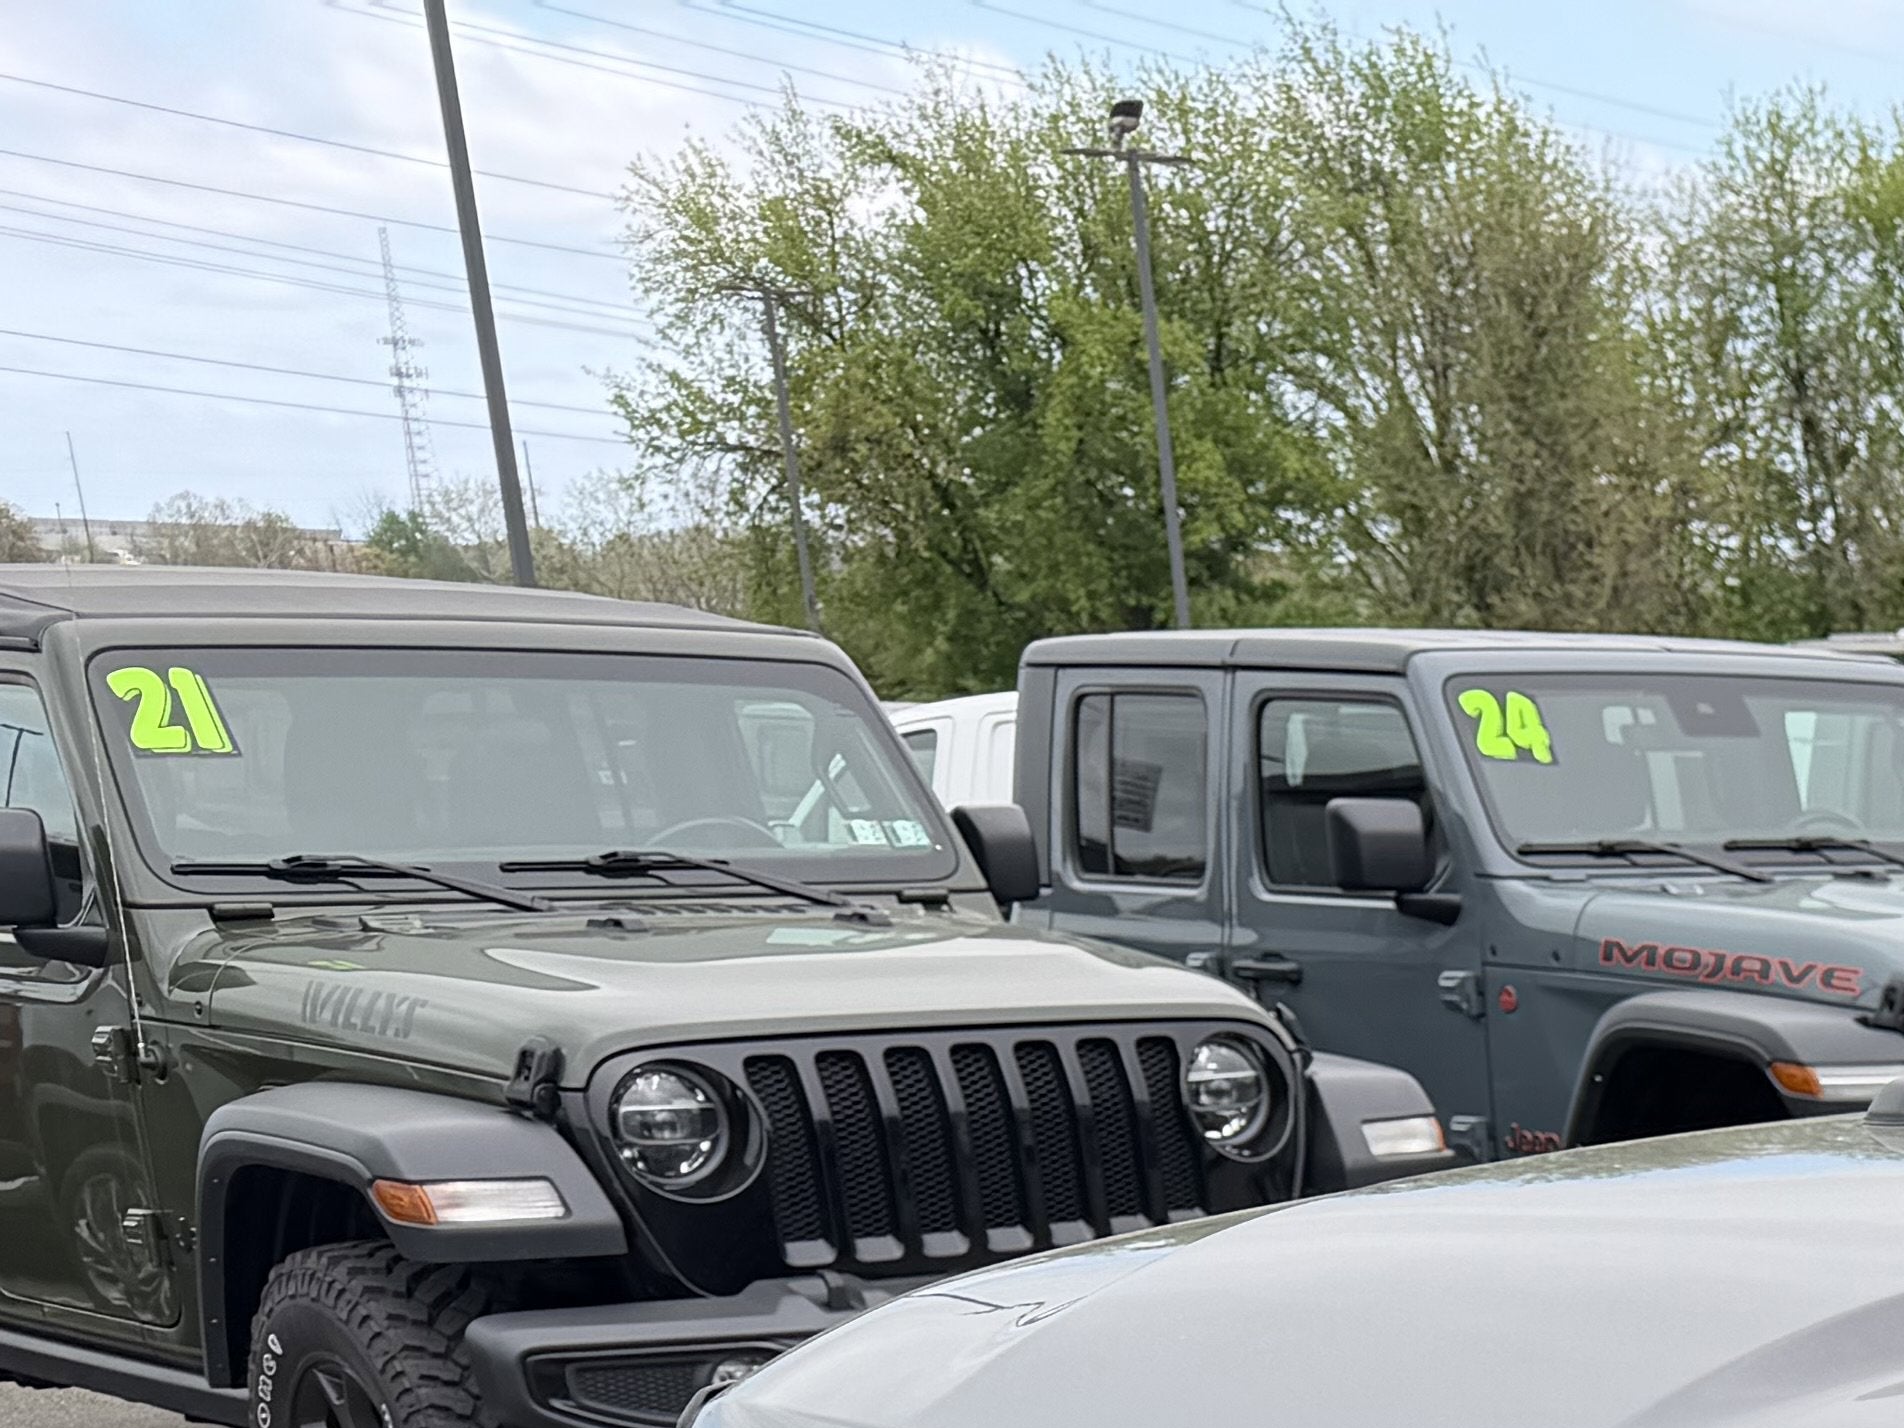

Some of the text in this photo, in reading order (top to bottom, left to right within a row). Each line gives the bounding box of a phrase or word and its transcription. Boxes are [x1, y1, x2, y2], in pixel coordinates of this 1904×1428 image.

[106, 666, 233, 753] 21
[1458, 689, 1552, 763] 24
[1600, 936, 1865, 998] MOJAVE
[301, 980, 430, 1039] WILLYS
